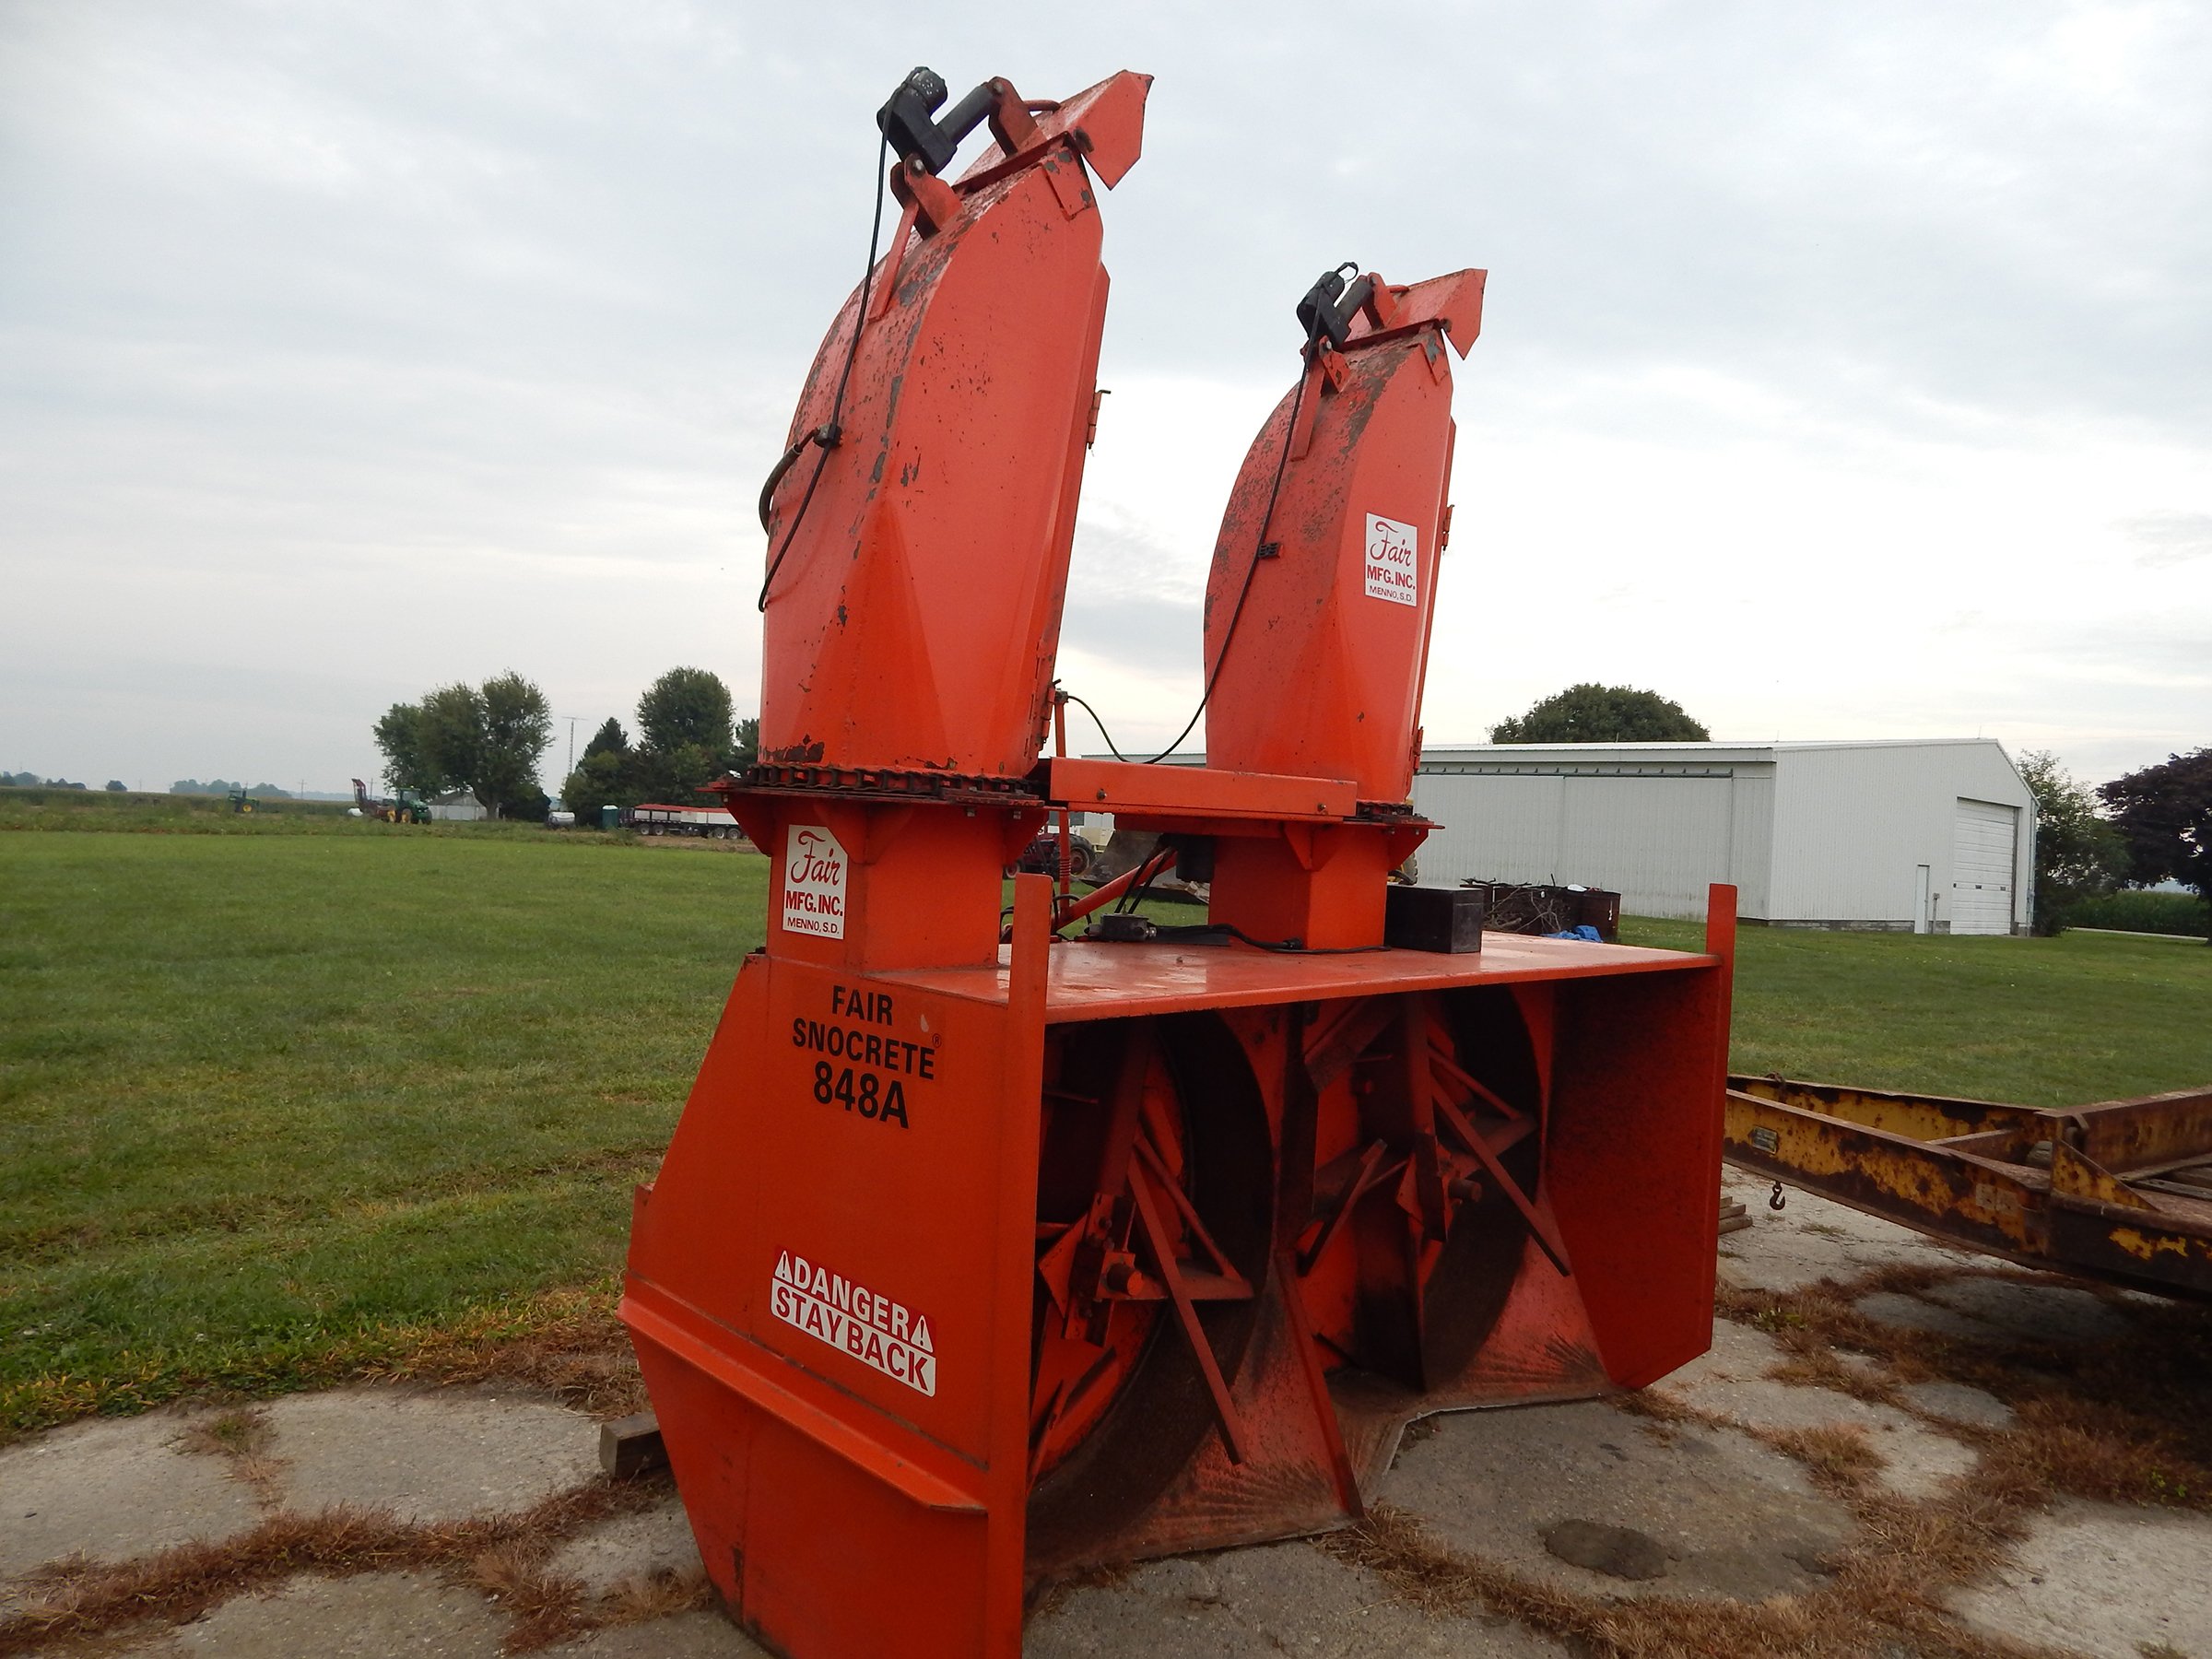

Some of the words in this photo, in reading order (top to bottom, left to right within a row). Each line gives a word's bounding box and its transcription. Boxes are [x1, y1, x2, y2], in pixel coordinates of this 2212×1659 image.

[1370, 521, 1412, 567] Fair
[1367, 564, 1394, 585] MFG.
[1395, 571, 1416, 590] INC.
[791, 830, 841, 886] Fair
[785, 890, 817, 913] MFG.
[818, 895, 843, 916] INC.
[831, 985, 893, 1026] FAIR
[814, 1061, 909, 1129] 848A
[794, 1256, 910, 1341] DANGER
[776, 1287, 843, 1344] STAY
[846, 1320, 929, 1392] BACK
